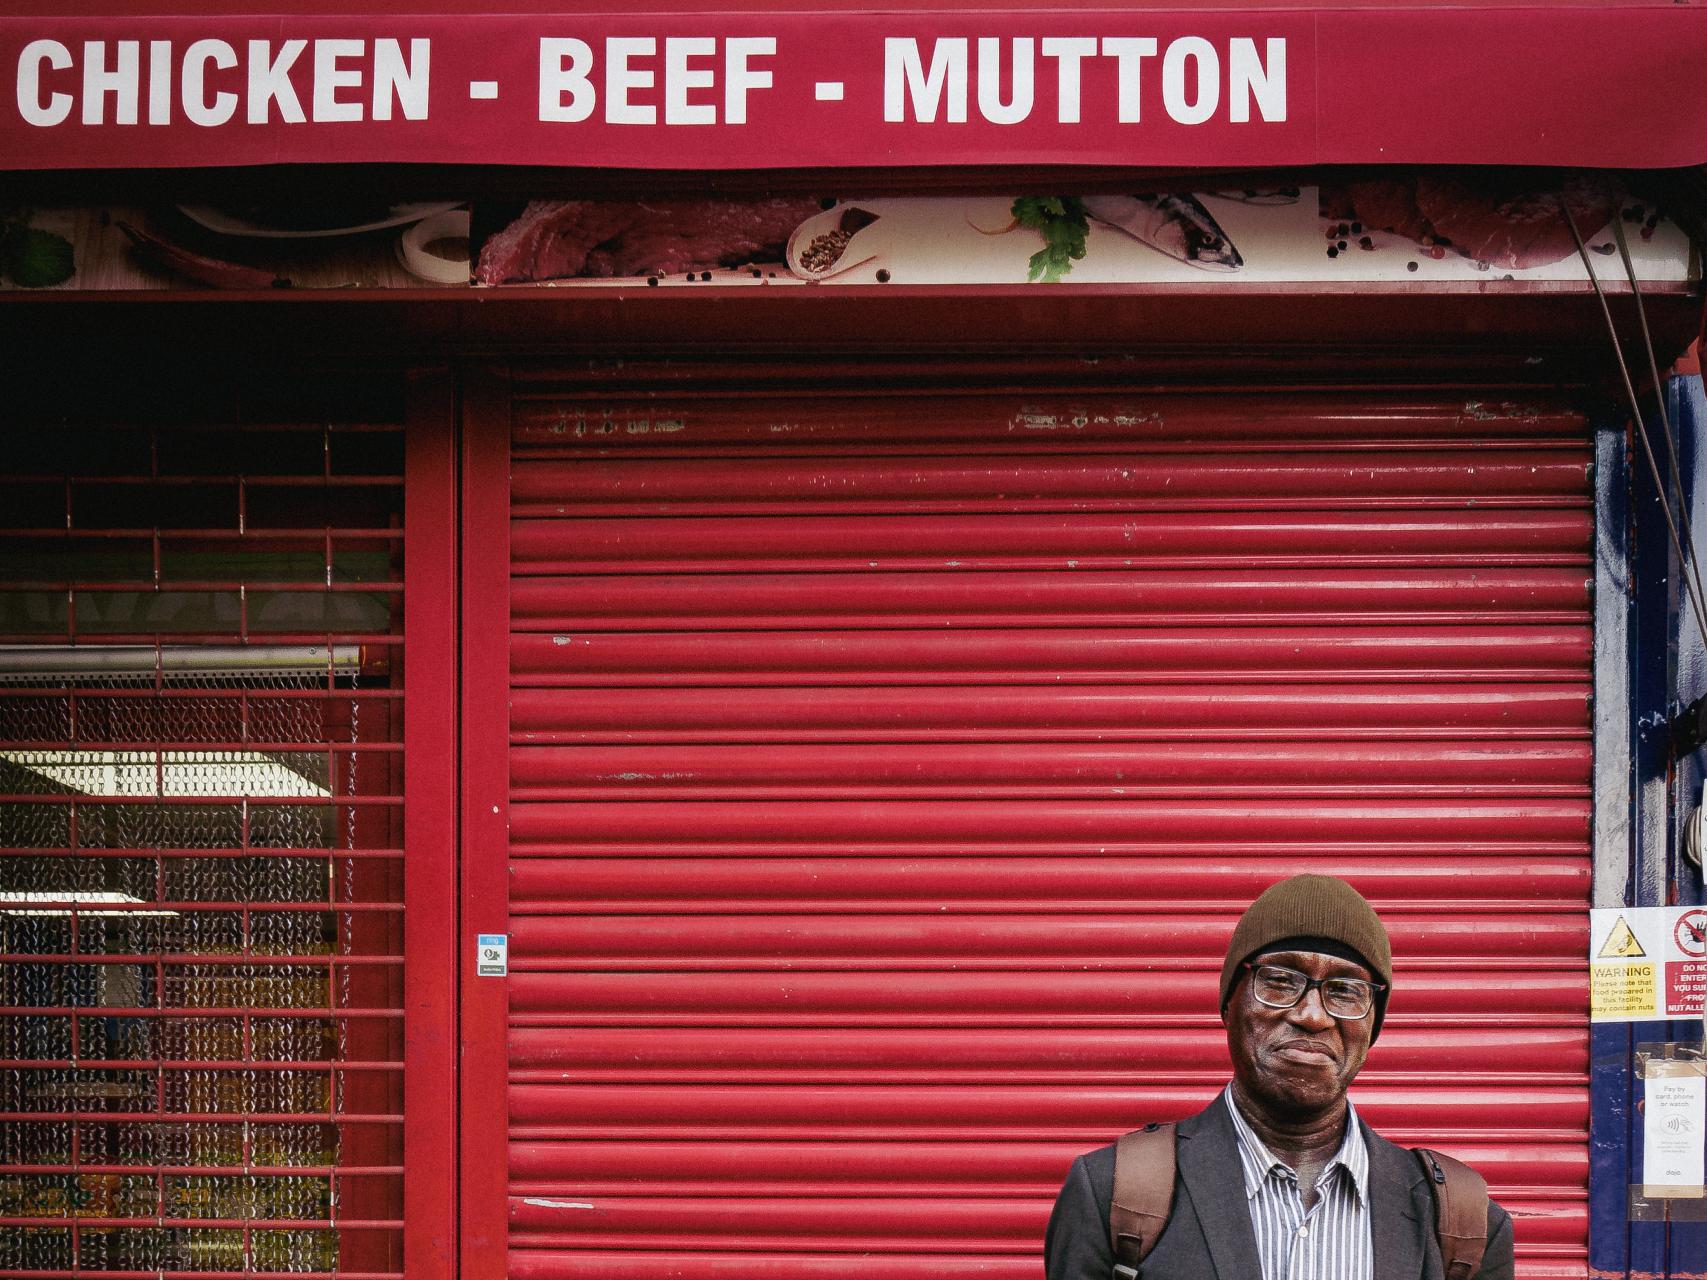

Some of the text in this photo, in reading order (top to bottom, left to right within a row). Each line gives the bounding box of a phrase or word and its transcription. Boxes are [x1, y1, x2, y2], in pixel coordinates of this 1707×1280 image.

[16, 36, 1287, 128] CHICKEN - BEEF - MUTTON
[1594, 967, 1651, 977] WARNING
[1611, 988, 1643, 996] prepared
[1673, 984, 1691, 992] YOU
[1618, 996, 1643, 1004] facility
[1668, 1004, 1684, 1012] NUT
